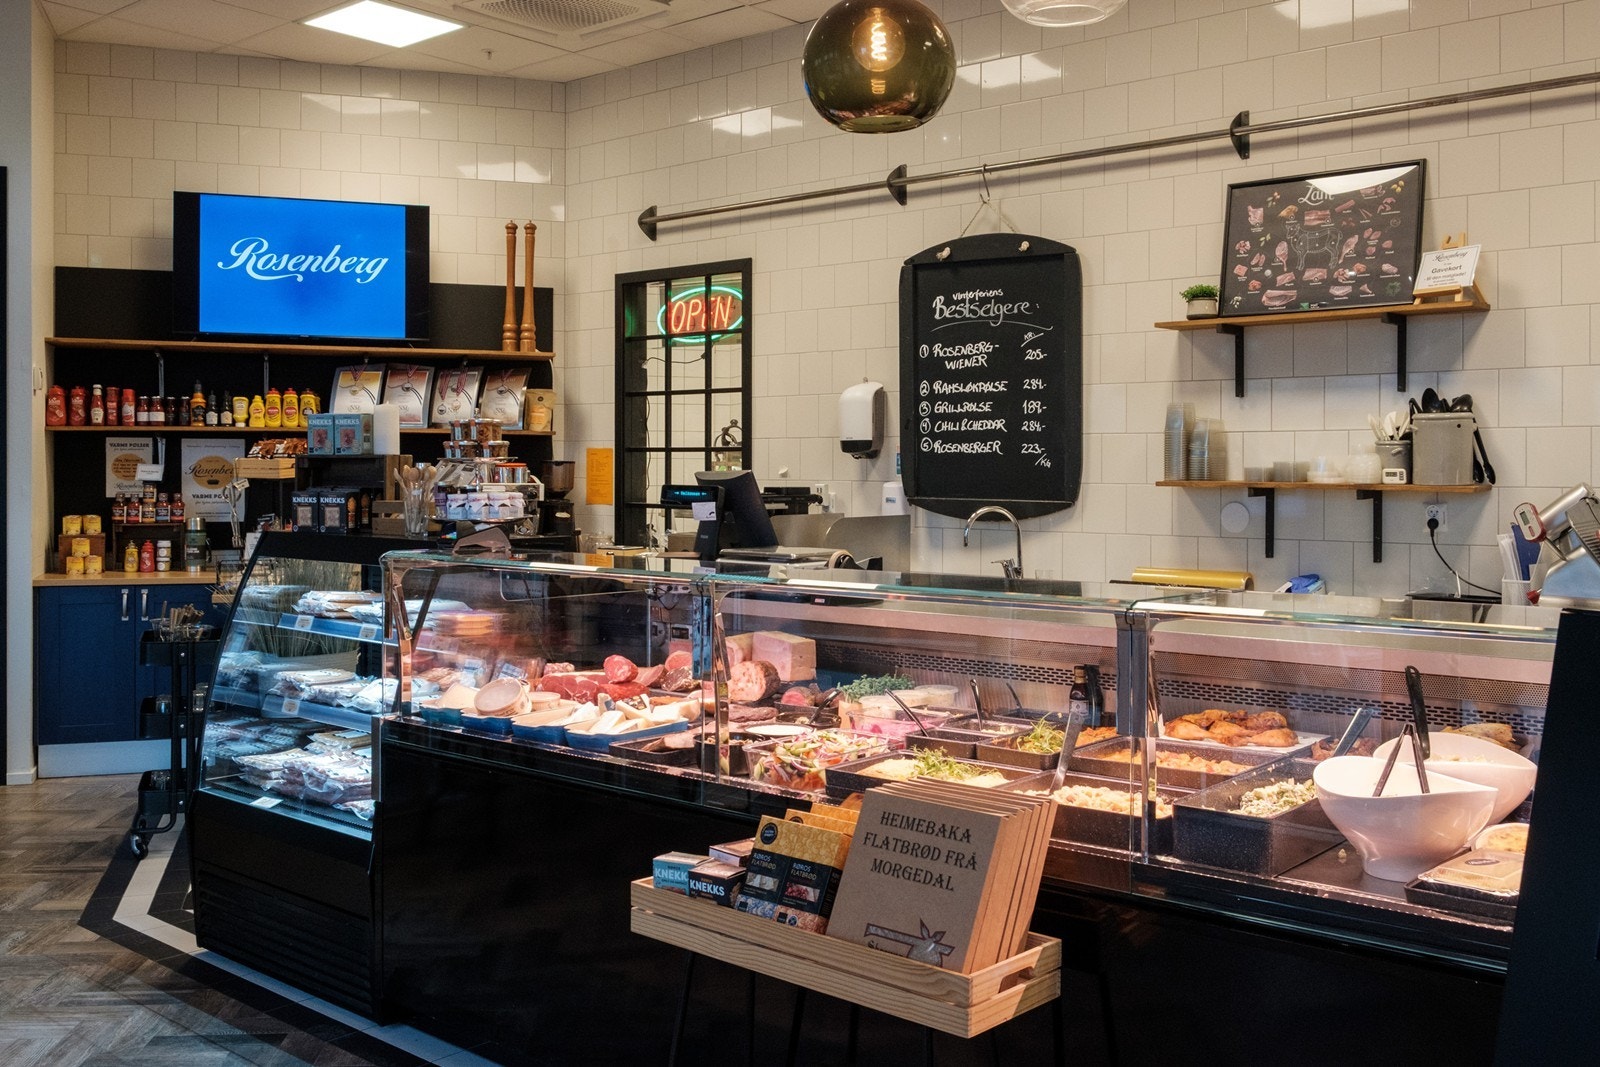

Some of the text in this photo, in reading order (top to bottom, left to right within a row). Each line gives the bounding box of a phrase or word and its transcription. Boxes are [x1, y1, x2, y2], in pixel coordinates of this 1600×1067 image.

[217, 236, 389, 284] Rosenberg
[1432, 265, 1462, 273] Gavekort
[945, 354, 988, 370] WIENER
[934, 401, 994, 414] GRILLPØLSE
[934, 440, 1004, 455] ROSENBERGER
[292, 496, 317, 504] KNEKKS
[880, 811, 972, 844] HEIMEBAKA
[863, 831, 978, 871] FLATBRØD FRÅ
[654, 868, 688, 881] KNEKK
[790, 869, 817, 881] FLATBRØD
[870, 858, 954, 892] MORGEDAL
[690, 880, 725, 896] KNEKKS
